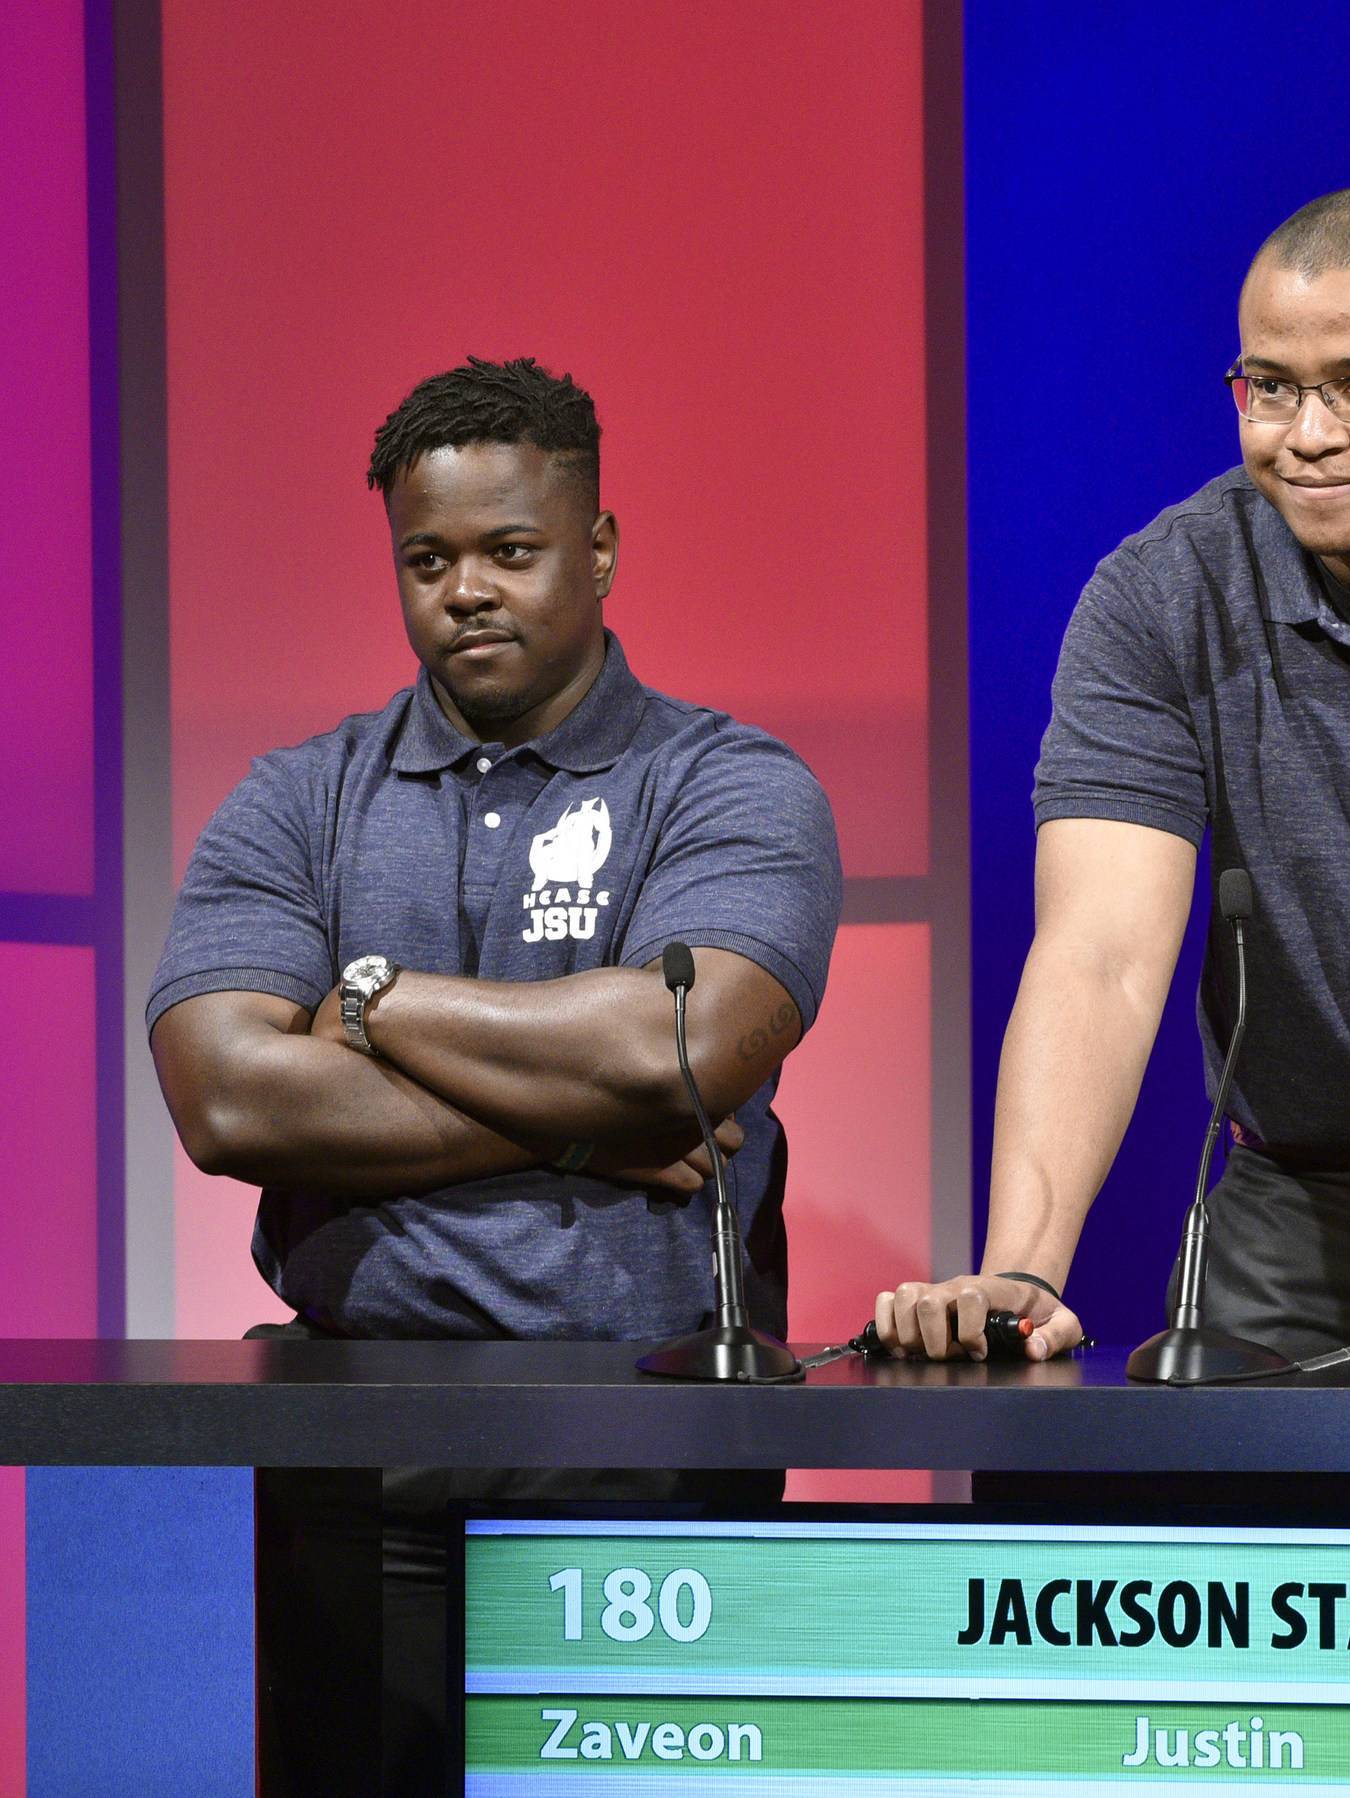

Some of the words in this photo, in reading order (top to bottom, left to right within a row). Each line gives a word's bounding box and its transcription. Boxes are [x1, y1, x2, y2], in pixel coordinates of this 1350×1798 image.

[522, 888, 610, 908] HCASC
[522, 907, 598, 943] JSU
[548, 1566, 713, 1643] 180
[957, 1577, 1250, 1649] JACKSON
[540, 1708, 763, 1762] Zaveon
[1122, 1715, 1305, 1770] Justin
